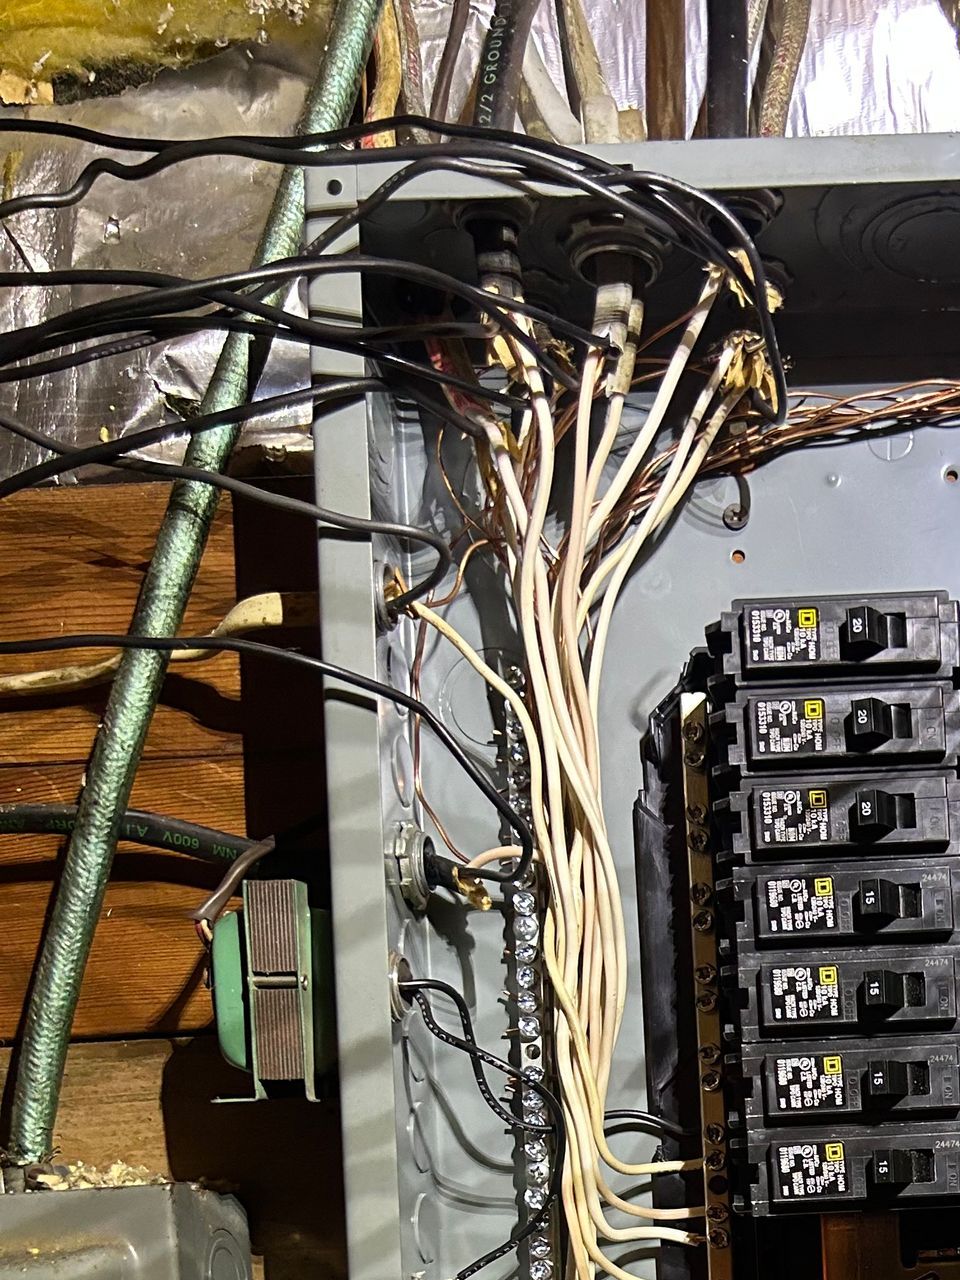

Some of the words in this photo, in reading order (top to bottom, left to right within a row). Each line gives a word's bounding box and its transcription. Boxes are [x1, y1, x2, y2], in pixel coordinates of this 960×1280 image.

[484, 18, 507, 85] GROUND
[853, 617, 863, 633] 20
[808, 642, 816, 660] HOM
[857, 709, 868, 724] 20
[814, 733, 822, 750] HOM
[861, 801, 872, 816] 20
[819, 822, 828, 840] HOM
[163, 831, 199, 849] 600V
[212, 844, 237, 860] NM
[922, 873, 947, 882] 24474
[865, 890, 875, 905] 15
[826, 910, 834, 928] HOM
[925, 958, 949, 967] 24474
[870, 981, 879, 995] 15
[829, 998, 838, 1016] HOM
[930, 1055, 953, 1063] 24474
[873, 1071, 883, 1085] 15
[834, 1088, 843, 1105] HOM
[936, 1140, 960, 1149] 24474
[878, 1160, 888, 1174] 15
[837, 1174, 845, 1192] HOM
